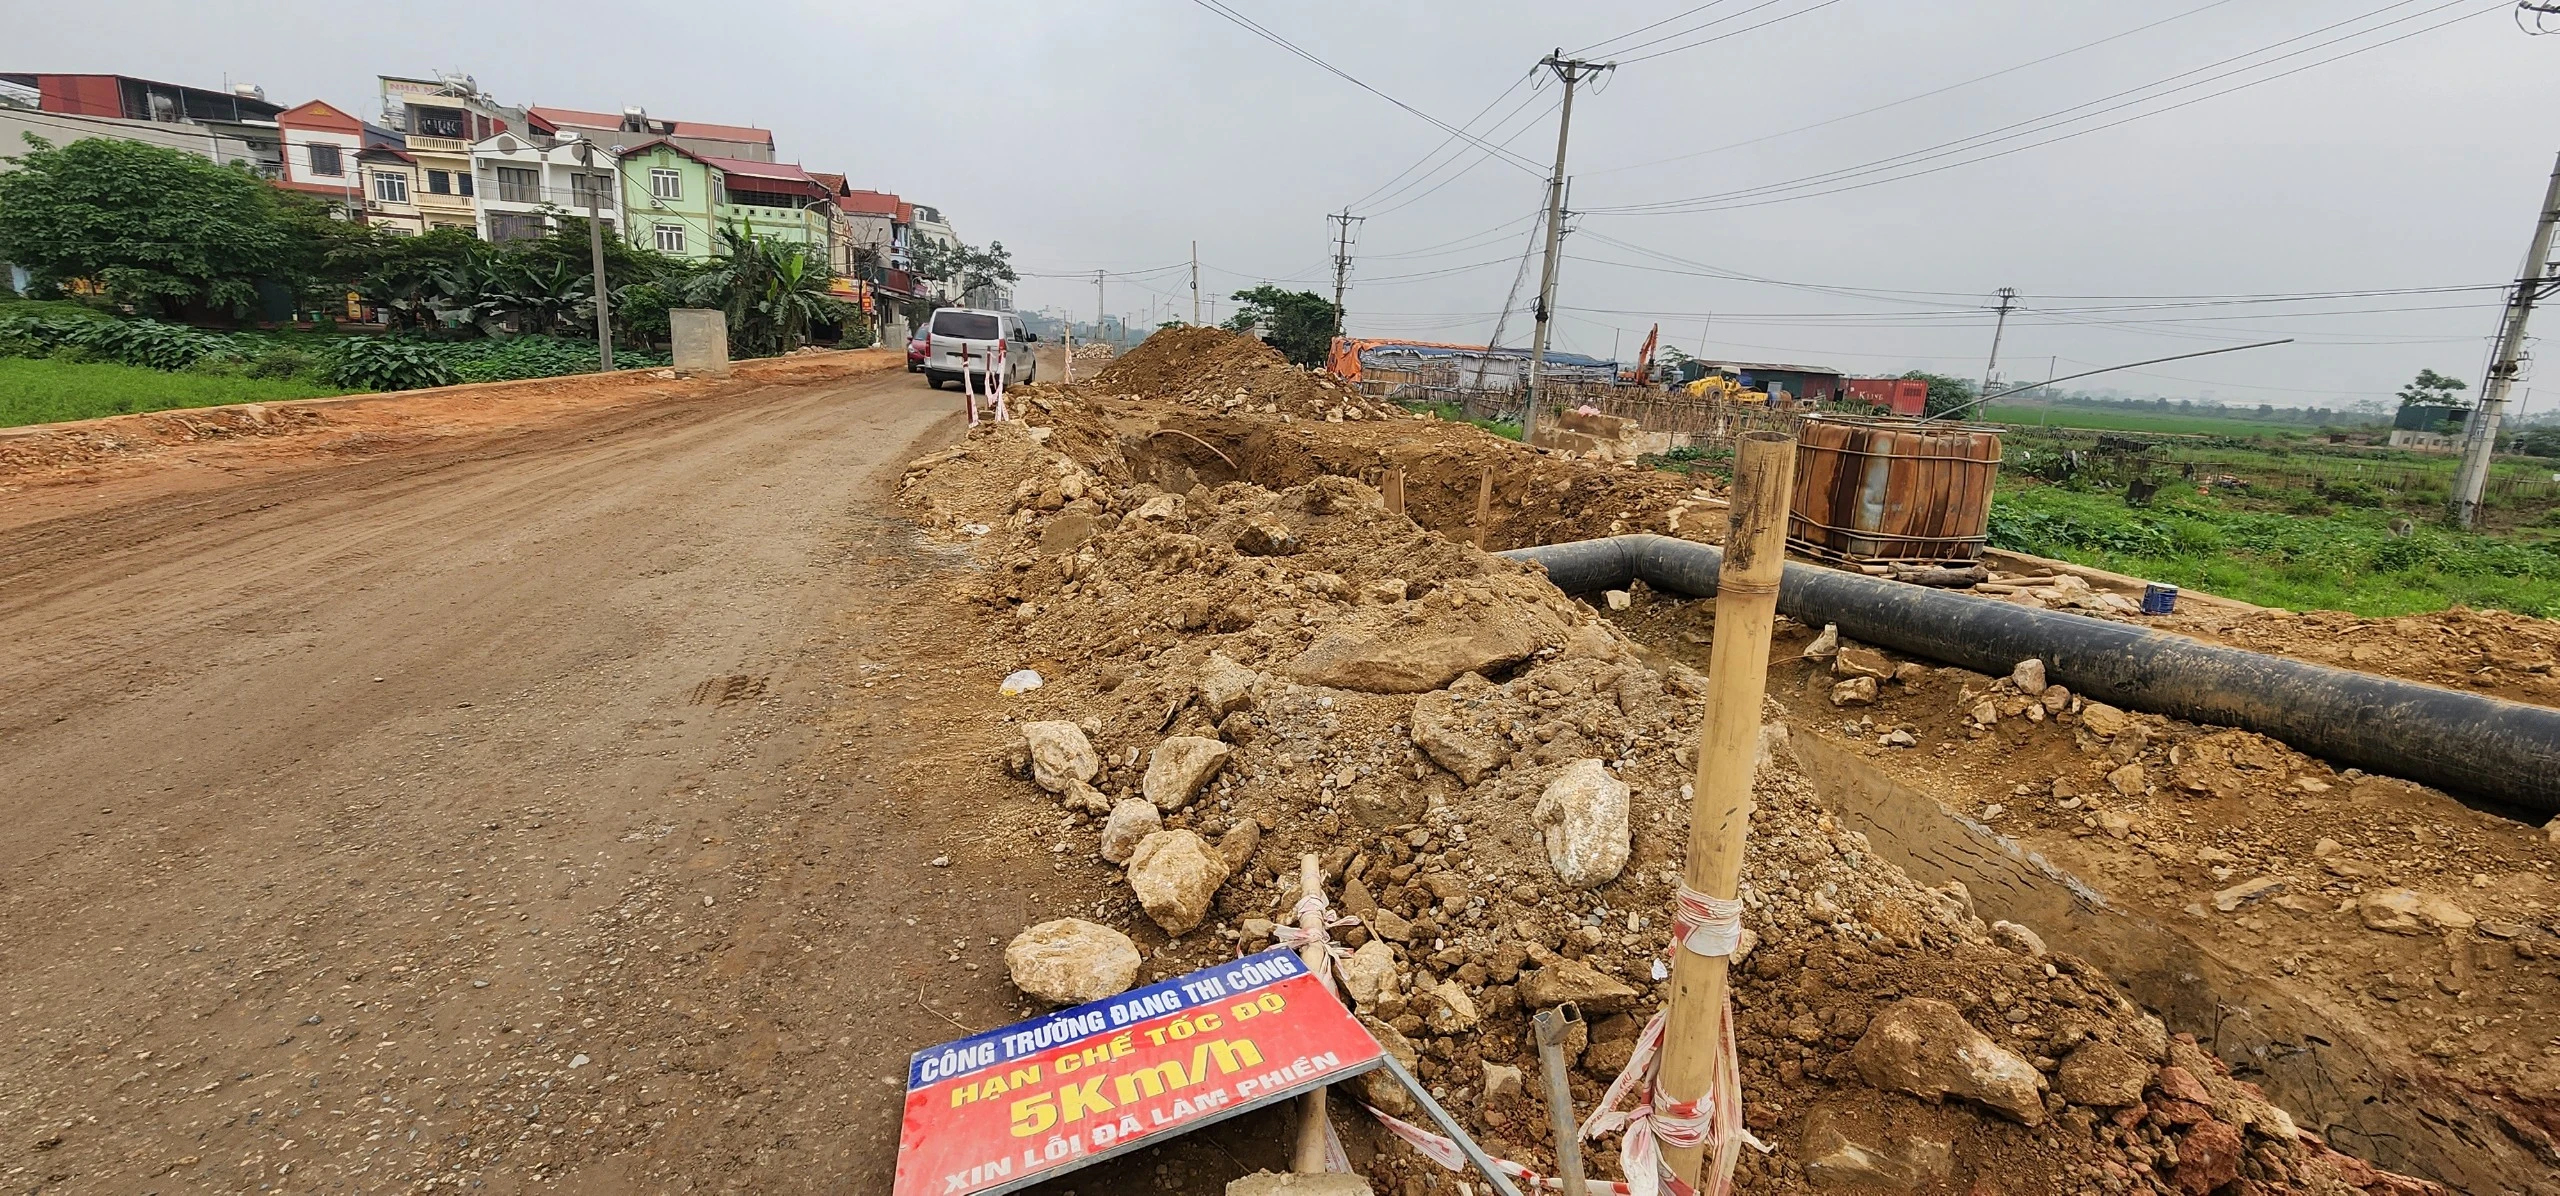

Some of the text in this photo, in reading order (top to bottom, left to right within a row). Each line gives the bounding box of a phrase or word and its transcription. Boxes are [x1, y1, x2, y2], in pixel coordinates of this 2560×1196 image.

[921, 956, 1298, 1082] CÔNG TRƯỜNG ĐANG THI CÔNG
[951, 992, 1287, 1108] HẠN CHẾ TỐC ĐỘ
[943, 1050, 1341, 1195] XIN LỖI ĐÃ LÀM PHIỀN
[1009, 1038, 1266, 1139] 5Km/h
